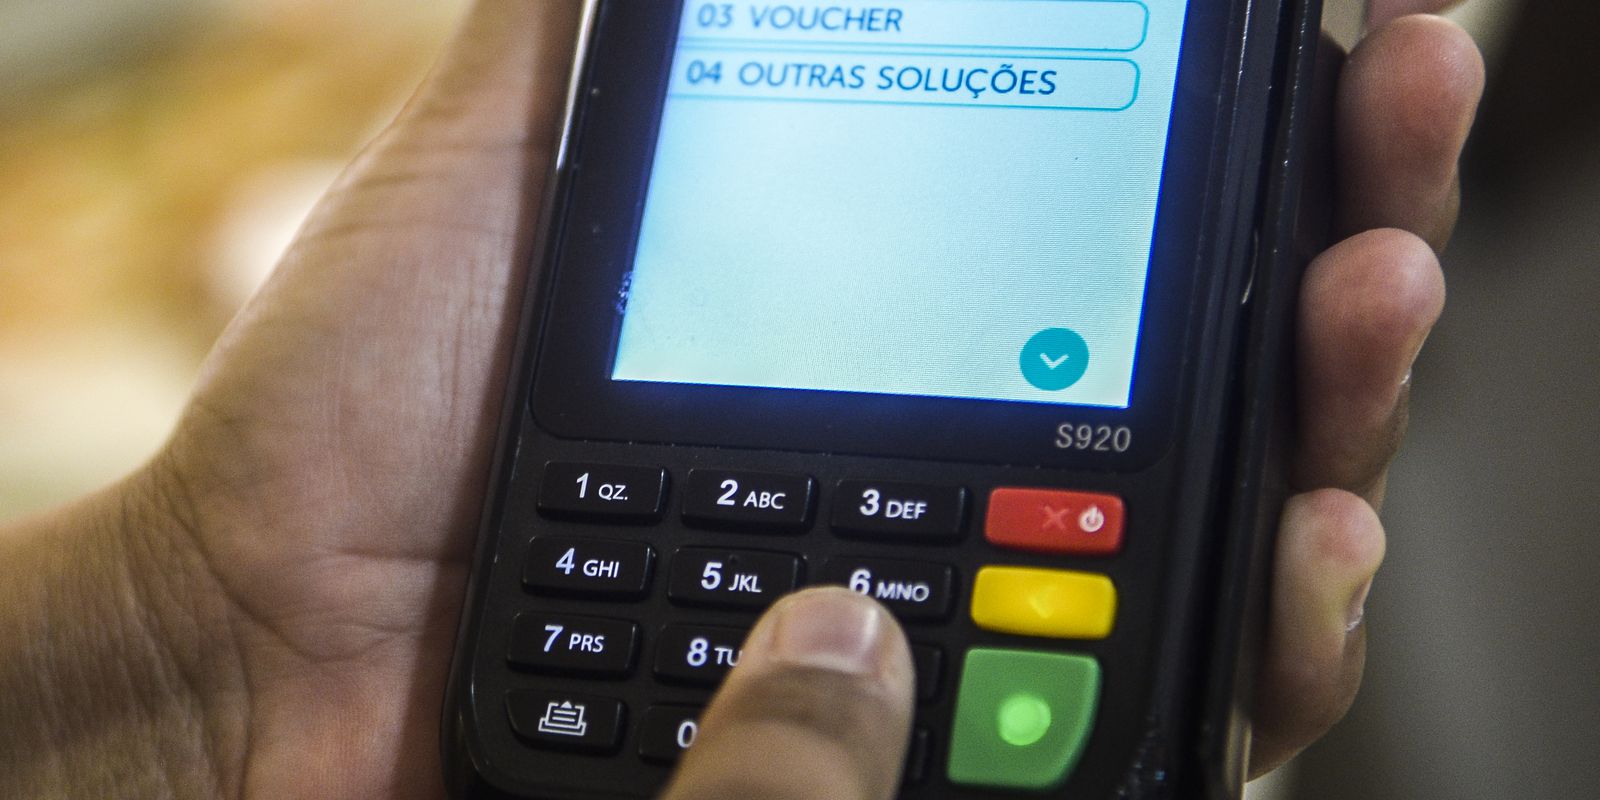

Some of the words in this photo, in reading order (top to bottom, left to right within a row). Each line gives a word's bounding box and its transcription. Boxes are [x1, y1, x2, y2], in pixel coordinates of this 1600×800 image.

[697, 3, 733, 28] 03
[750, 4, 904, 32] VOUCHER
[686, 61, 723, 85] 04
[738, 62, 866, 89] OUTRAS
[876, 64, 1058, 99] SOLUÇÕES
[1055, 423, 1132, 452] S920
[576, 472, 590, 499] 1
[716, 479, 738, 506] 2
[743, 492, 786, 510] ABC
[859, 488, 880, 516] 3
[885, 501, 927, 520] DEF
[555, 547, 576, 575] 4
[583, 559, 620, 579] GHI
[701, 562, 723, 590] 5
[728, 573, 762, 593] JKL
[849, 568, 872, 596] 6
[875, 581, 930, 602] MNO
[543, 624, 564, 653] 7
[568, 633, 605, 653] PRS
[686, 638, 709, 667] 8
[714, 647, 743, 667] TU
